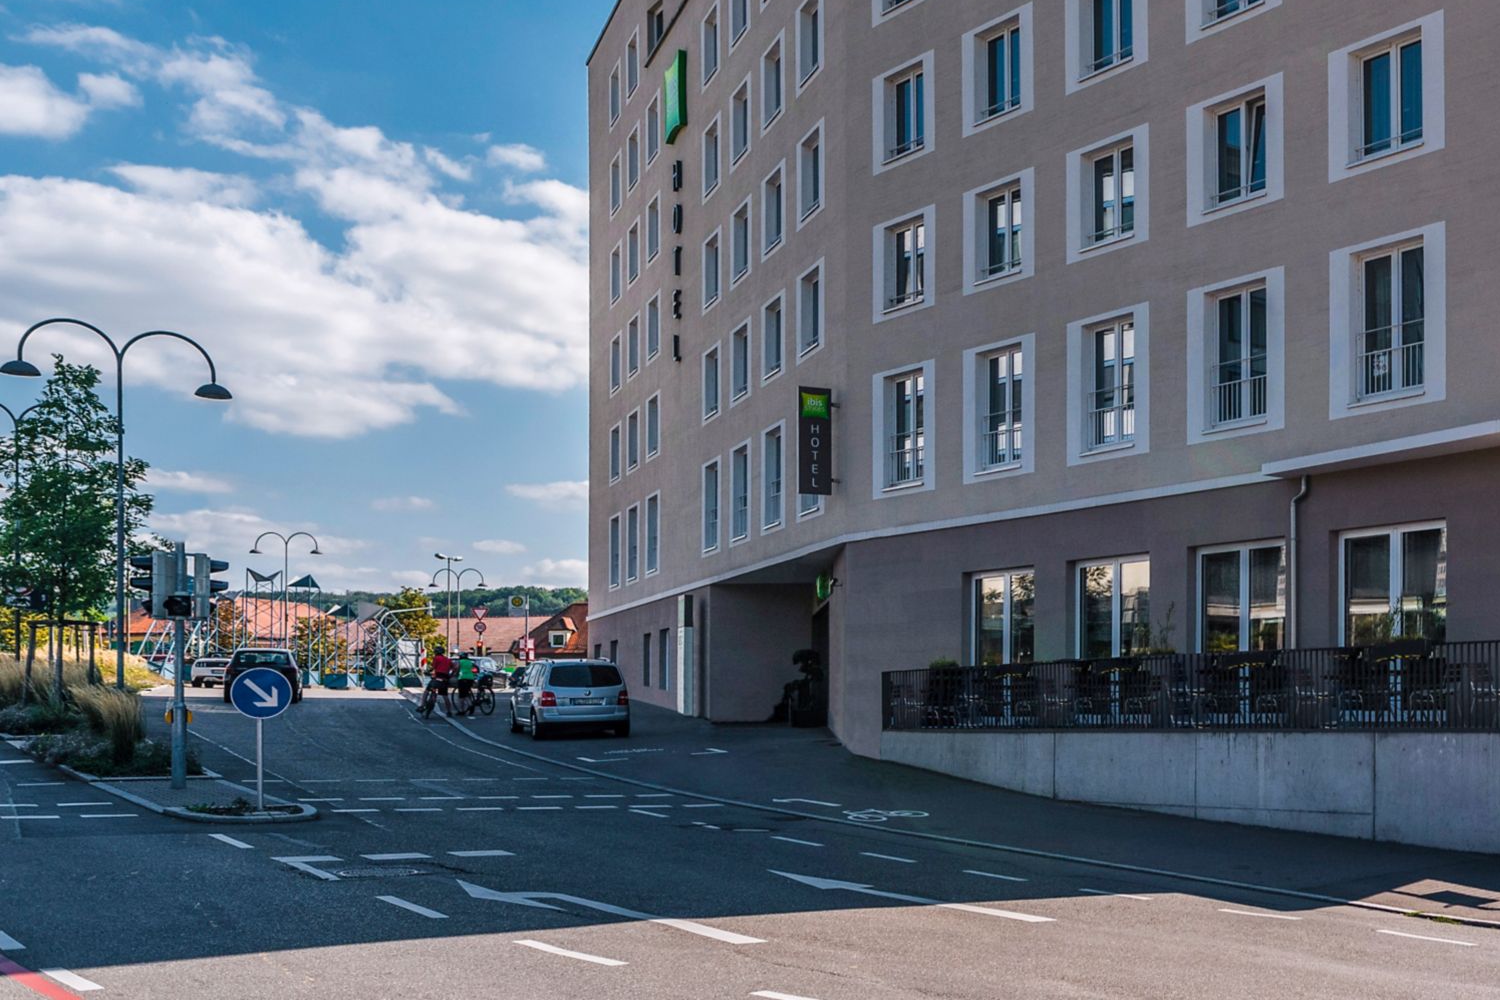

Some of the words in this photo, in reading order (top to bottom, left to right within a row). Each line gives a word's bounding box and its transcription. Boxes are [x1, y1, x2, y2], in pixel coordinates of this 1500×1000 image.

[672, 159, 683, 362] HOTEL
[807, 397, 823, 407] ibis
[811, 424, 820, 488] HOTEL
